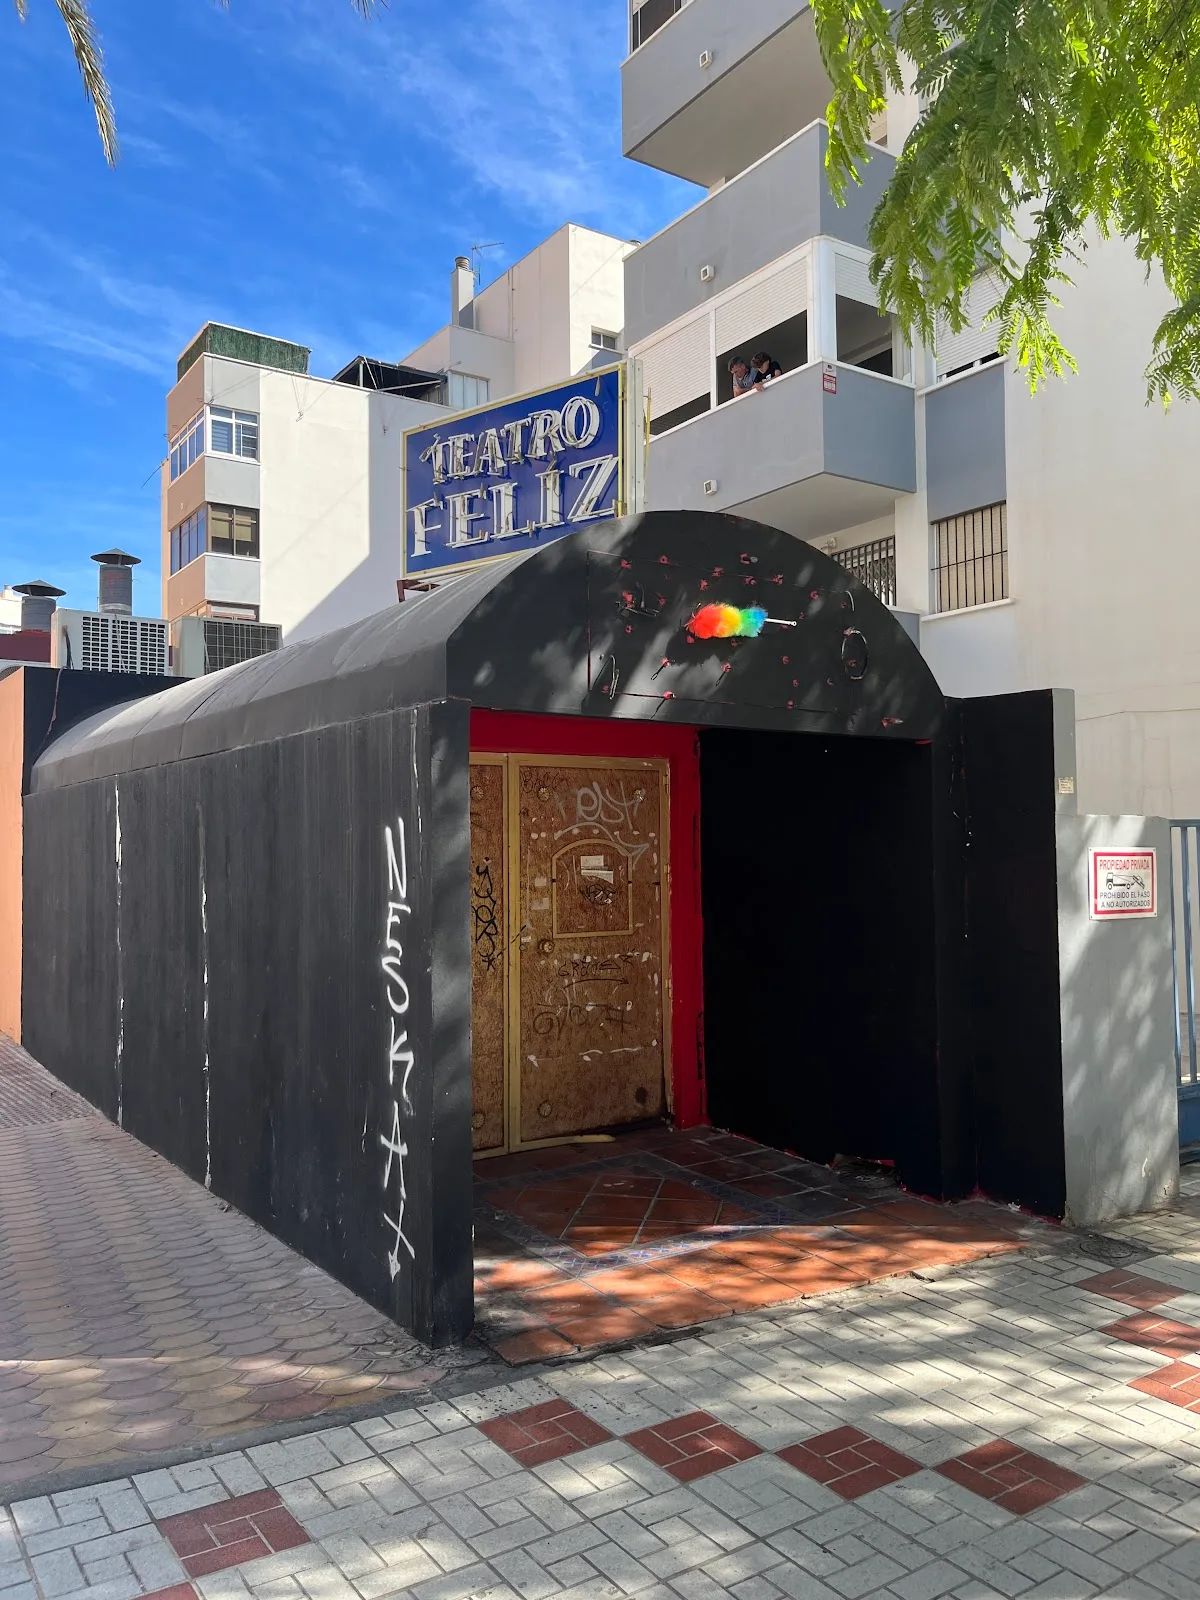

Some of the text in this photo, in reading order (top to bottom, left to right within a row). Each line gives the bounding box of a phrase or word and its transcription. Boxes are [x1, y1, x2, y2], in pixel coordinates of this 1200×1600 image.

[419, 396, 600, 485] TEATRO
[406, 454, 619, 558] FELIZ
[1100, 860, 1150, 870] PROPIEDAD PRIVADA
